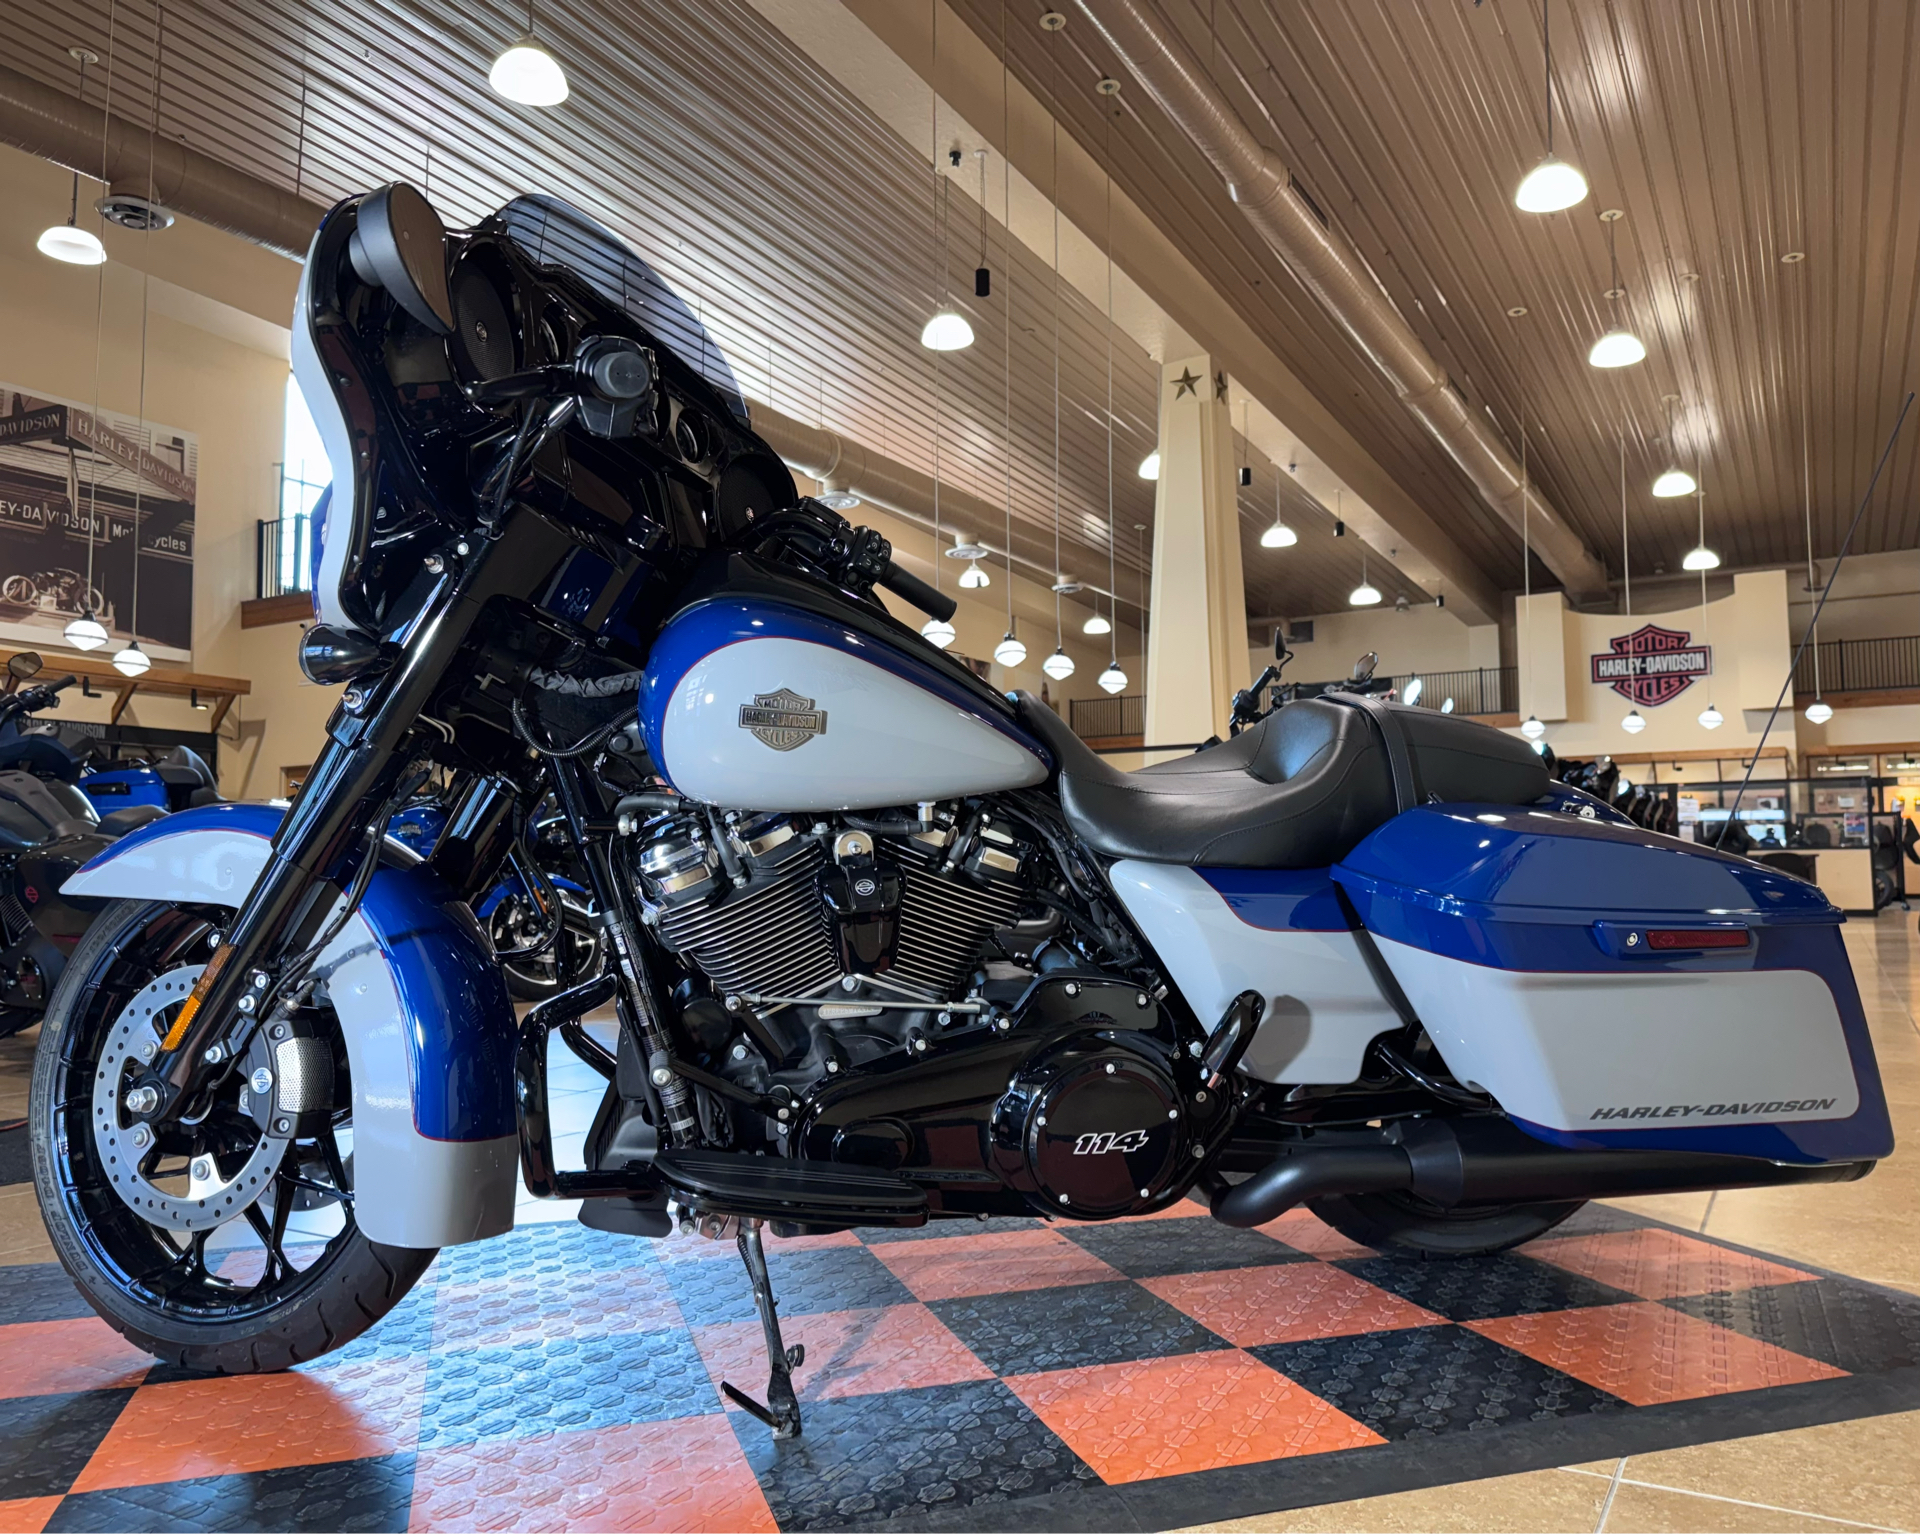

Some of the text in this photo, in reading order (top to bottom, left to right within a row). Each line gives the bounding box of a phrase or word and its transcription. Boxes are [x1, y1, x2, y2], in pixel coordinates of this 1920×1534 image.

[0, 412, 60, 437] DAVIDSON
[77, 417, 195, 496] HARLEY-DAVIDSON
[1622, 632, 1679, 653] MOTOR
[1598, 652, 1705, 677] HARLEY-DAVIDSON
[1623, 677, 1681, 700] CYCLES
[745, 708, 816, 728] HARLEY-DAVIDSON
[1589, 1098, 1839, 1121] HARLEY-DAVIDSON
[1072, 1129, 1149, 1155] 114
[50, 1210, 89, 1272] DUNLOP
